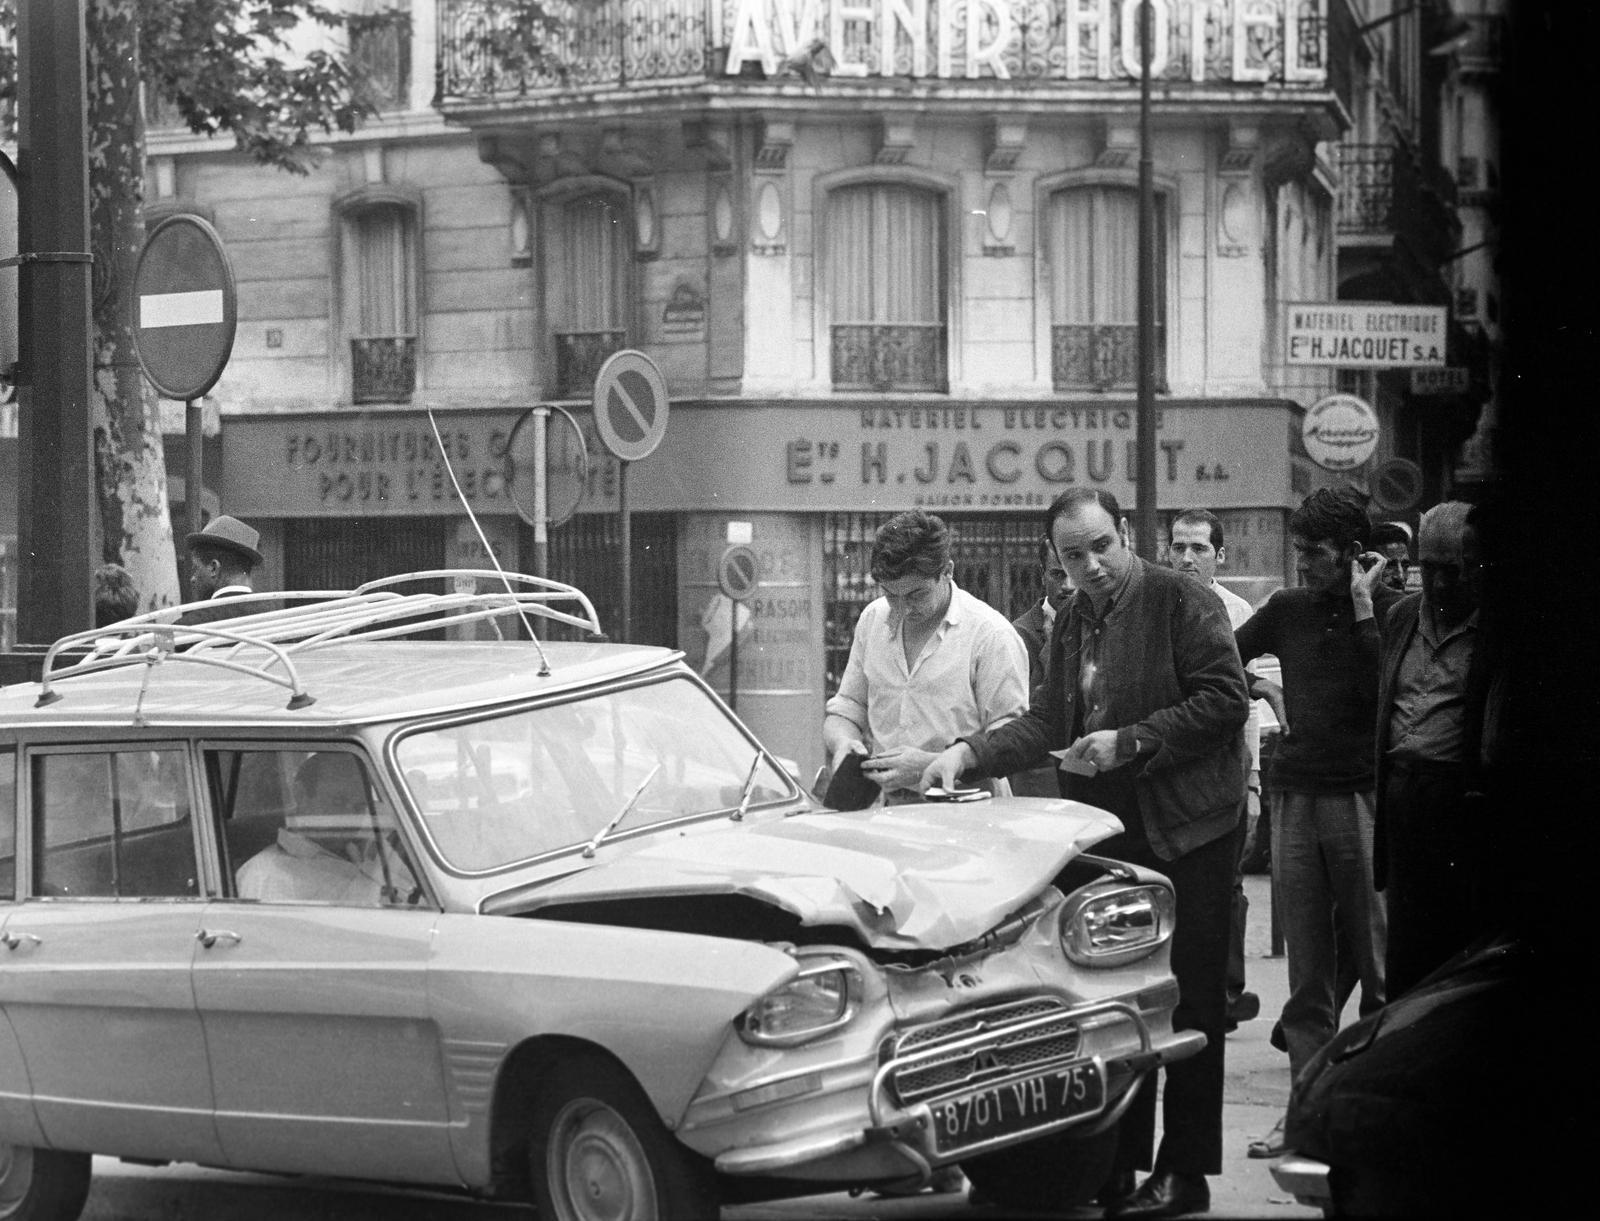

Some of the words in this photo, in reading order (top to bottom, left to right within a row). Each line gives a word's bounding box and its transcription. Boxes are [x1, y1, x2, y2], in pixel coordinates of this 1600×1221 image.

[726, 0, 1011, 79] AVENIR
[1295, 312, 1353, 332] MATERIEL
[1004, 408, 1164, 430] ELECTRIQE
[319, 472, 390, 501] POUR
[944, 1088, 1002, 1136] 8701
[1012, 1077, 1047, 1117] VH
[1056, 1067, 1086, 1106] 75
